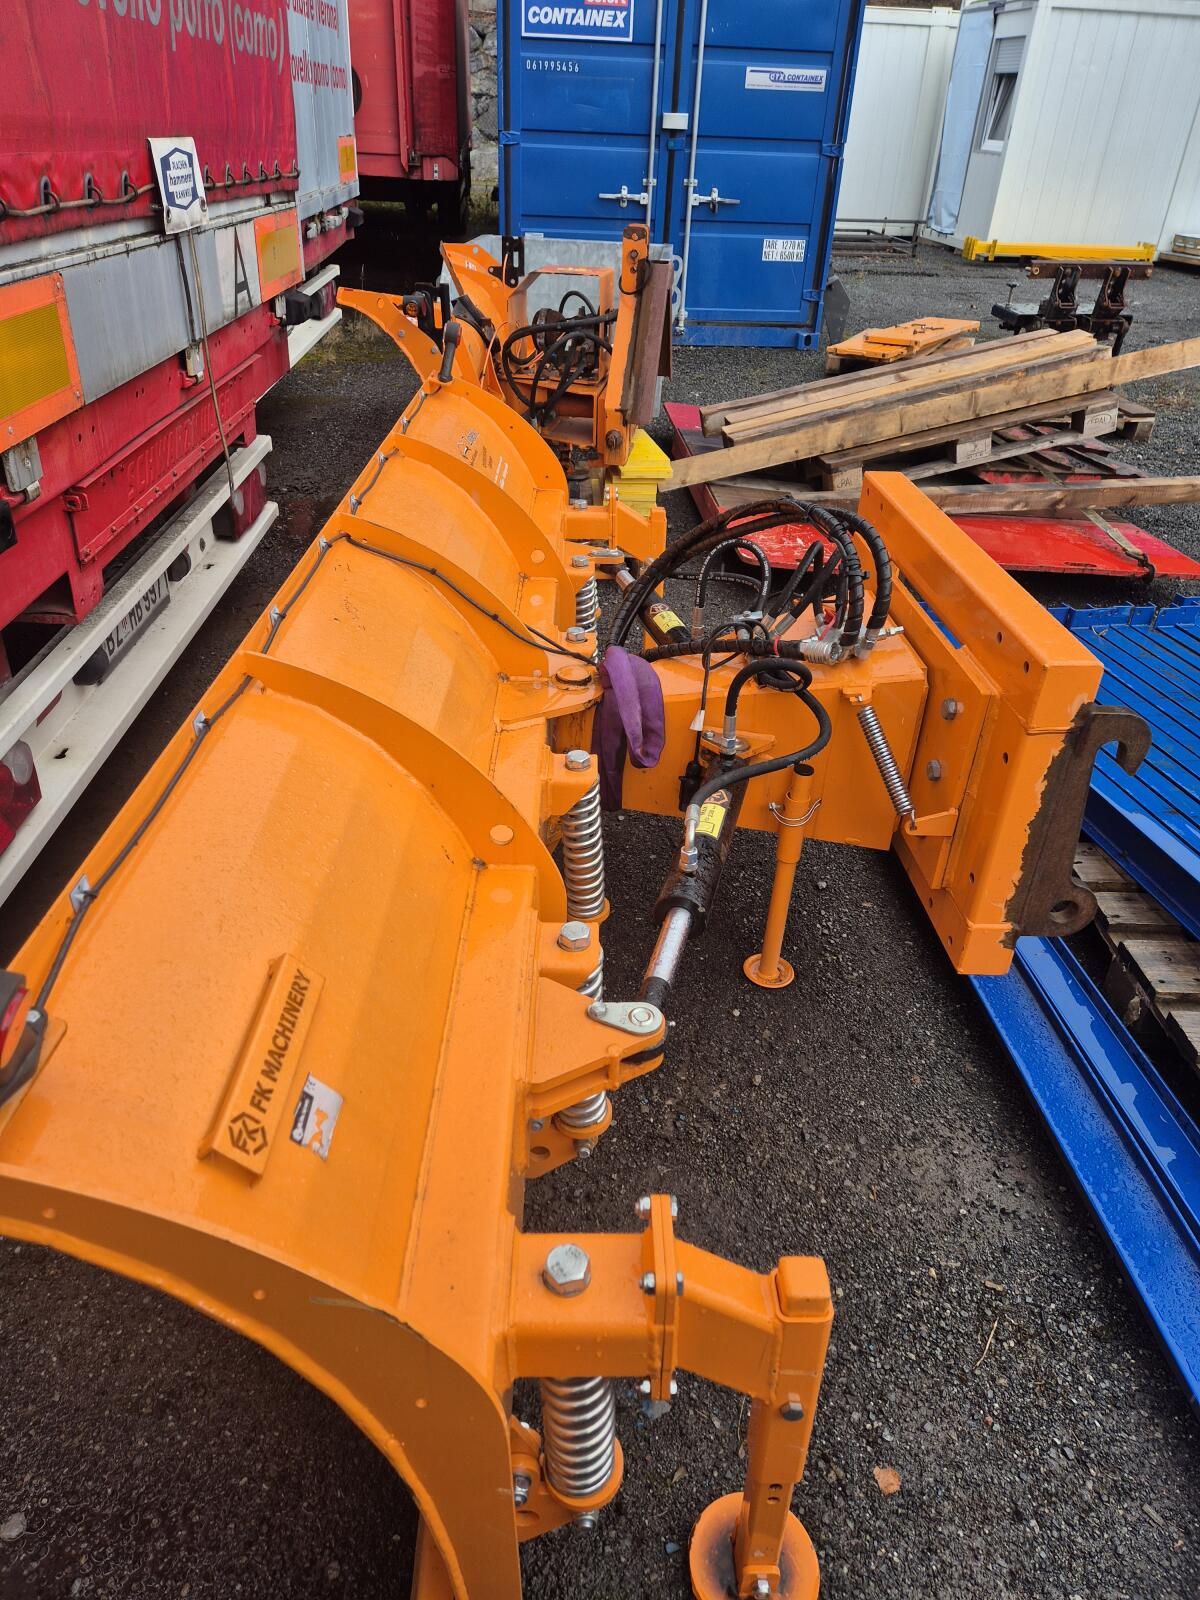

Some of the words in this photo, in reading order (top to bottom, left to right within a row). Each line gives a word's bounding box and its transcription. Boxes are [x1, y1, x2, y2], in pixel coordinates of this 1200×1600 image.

[527, 5, 628, 28] CONTAINEX
[227, 0, 285, 75] (como)
[526, 59, 579, 73] 061995456
[786, 73, 824, 82] CONTAINEX
[234, 226, 253, 318] A
[260, 968, 311, 1083] MACHINERY
[249, 1080, 274, 1115] FK
